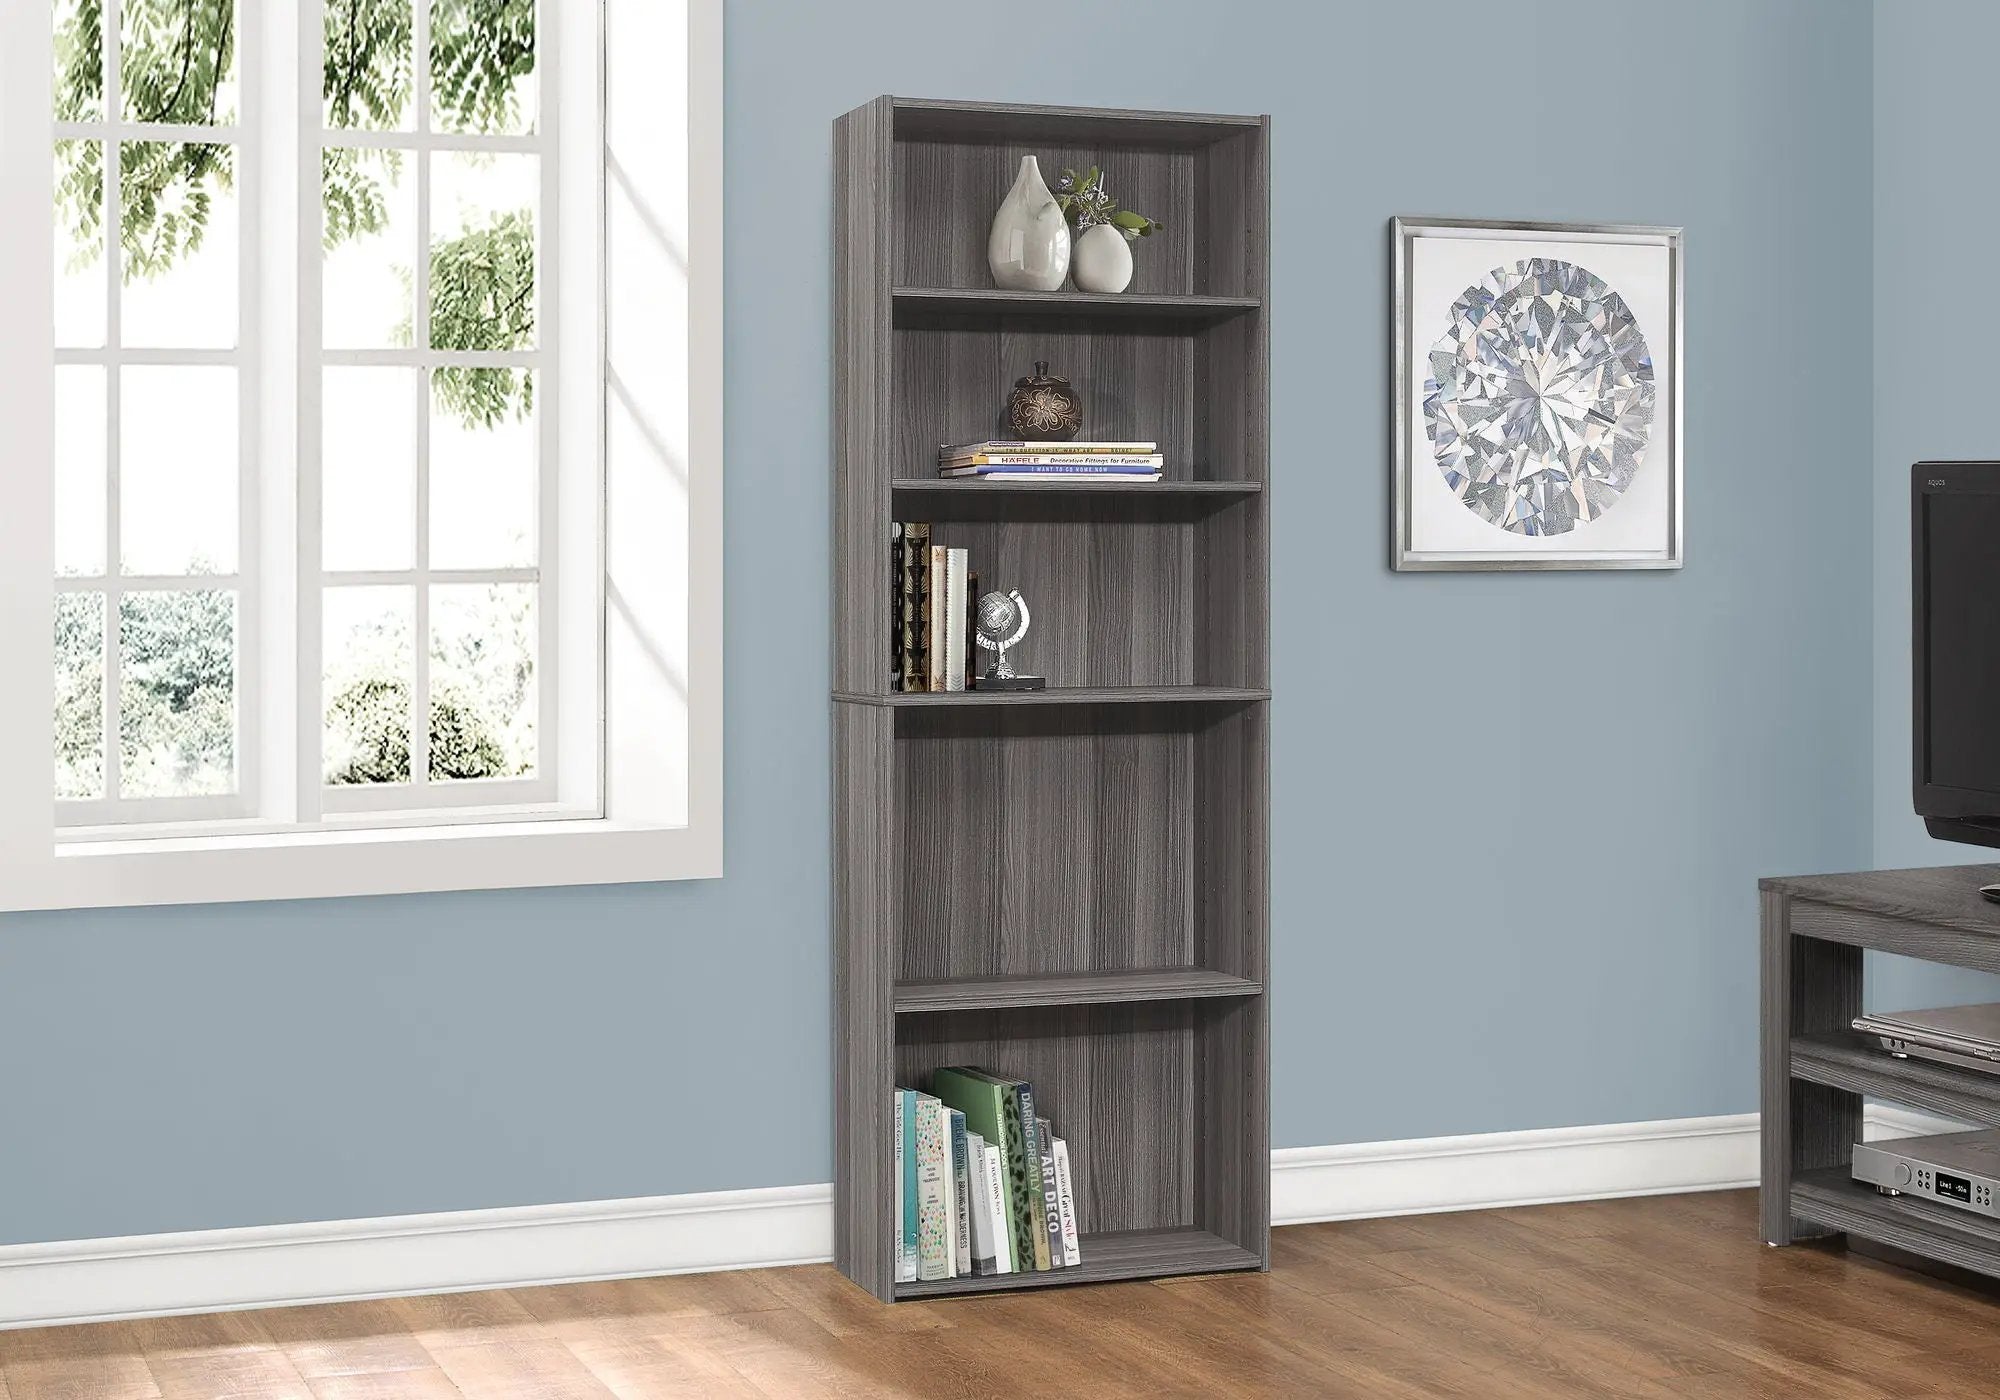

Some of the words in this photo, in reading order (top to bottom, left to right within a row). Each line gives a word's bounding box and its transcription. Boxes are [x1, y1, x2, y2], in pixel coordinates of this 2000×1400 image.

[1021, 1092, 1035, 1138] DARING
[1026, 1140, 1041, 1192] GREATLY
[1041, 1156, 1055, 1185] ART
[1045, 1191, 1059, 1233] DECO
